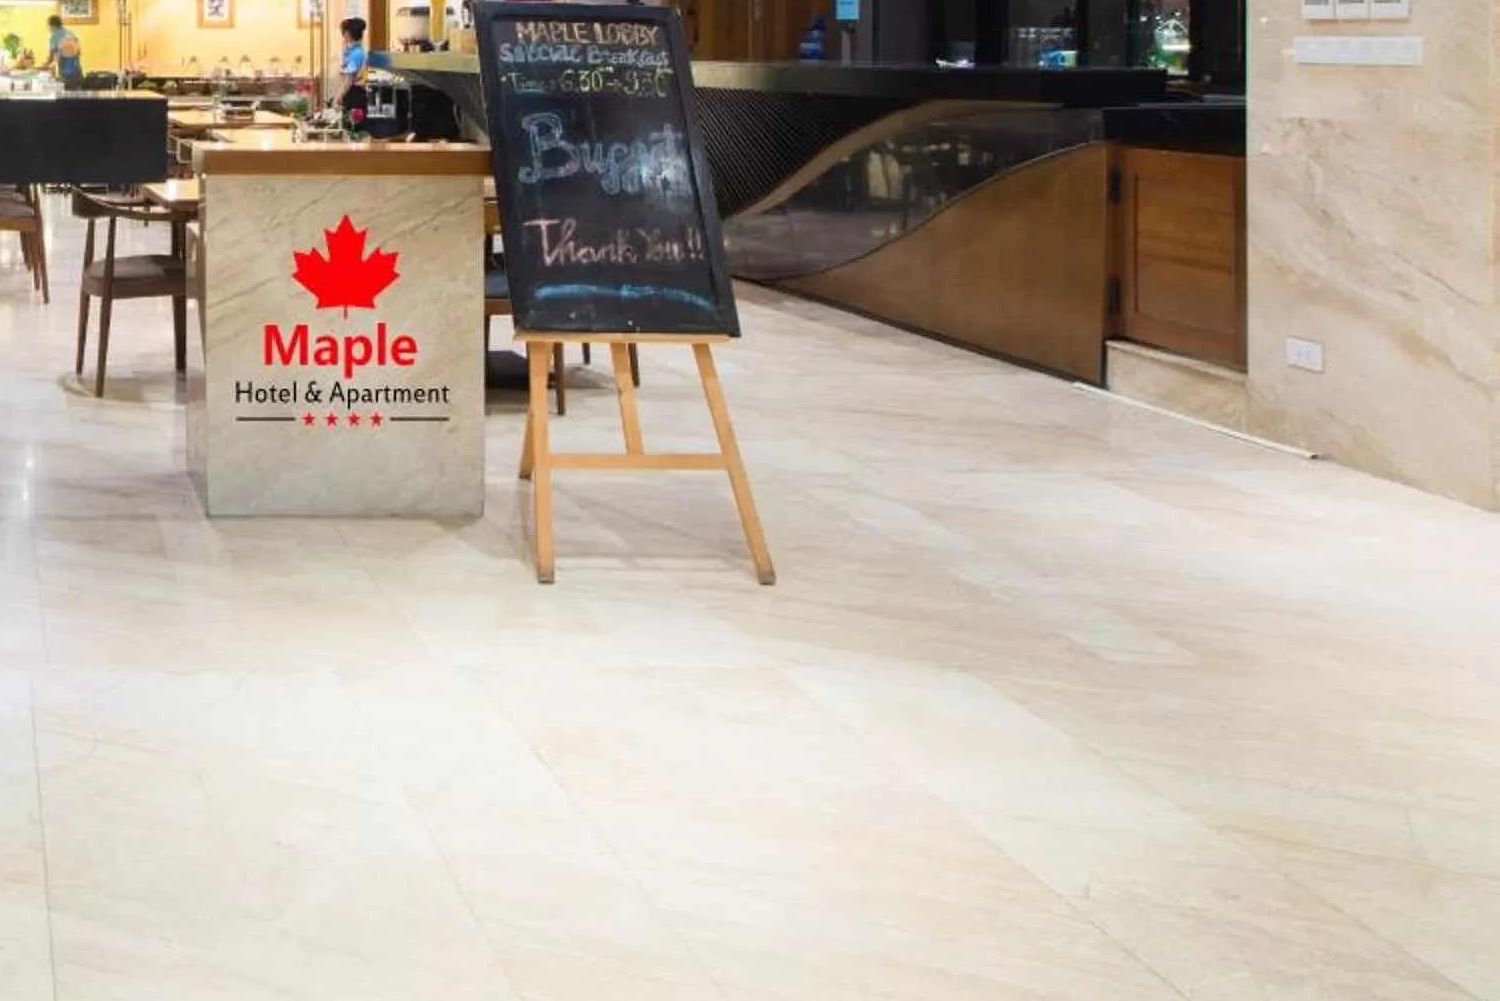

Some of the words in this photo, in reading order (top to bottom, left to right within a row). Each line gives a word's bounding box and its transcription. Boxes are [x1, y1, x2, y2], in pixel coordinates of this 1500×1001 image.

[515, 21, 591, 44] MAPLE
[593, 22, 660, 46] LOBBY
[523, 217, 638, 267] Thank
[263, 322, 418, 380] Maple
[234, 381, 297, 404] Hotel
[304, 381, 322, 404] &
[329, 381, 450, 410] Apartment
